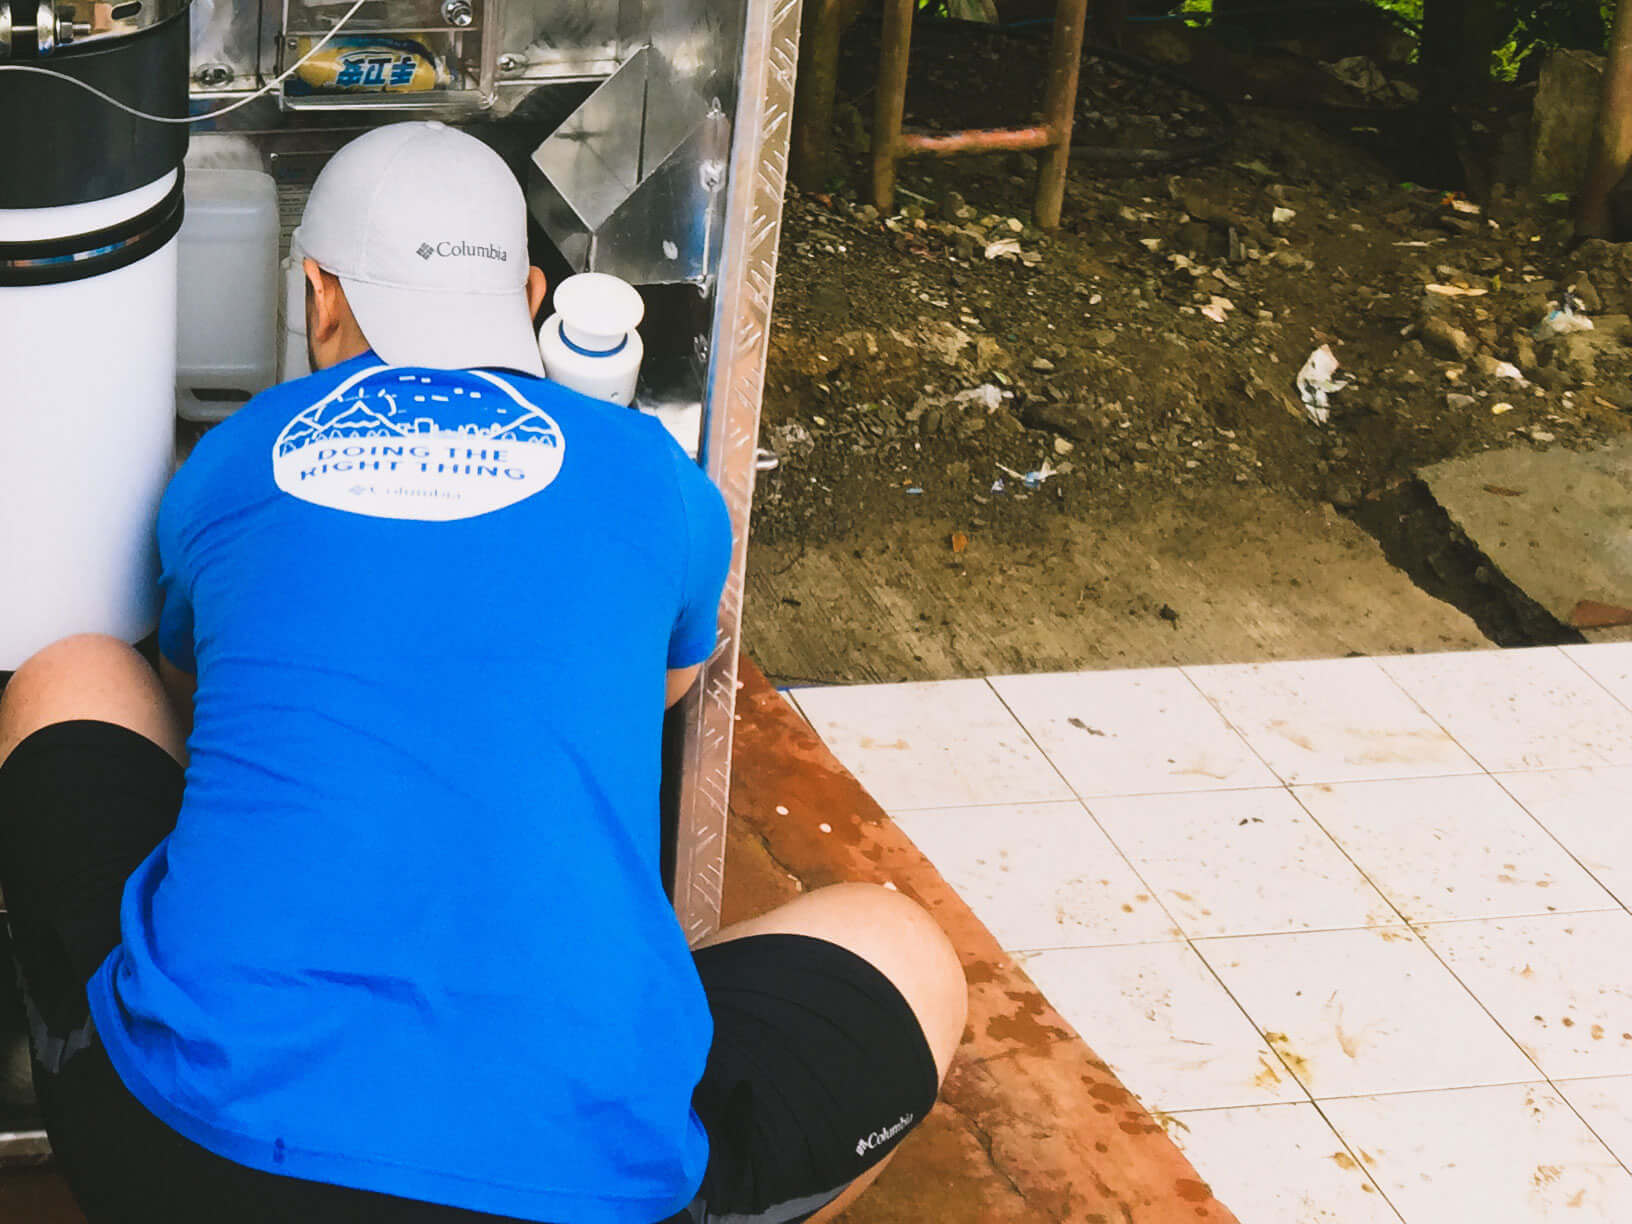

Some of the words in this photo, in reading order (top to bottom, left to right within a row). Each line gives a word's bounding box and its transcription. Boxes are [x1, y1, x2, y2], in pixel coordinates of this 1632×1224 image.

[436, 240, 508, 262] Columbia
[318, 446, 430, 460] DOING
[445, 447, 510, 462] THE
[300, 460, 404, 481] RIGHT
[415, 461, 526, 480] THING
